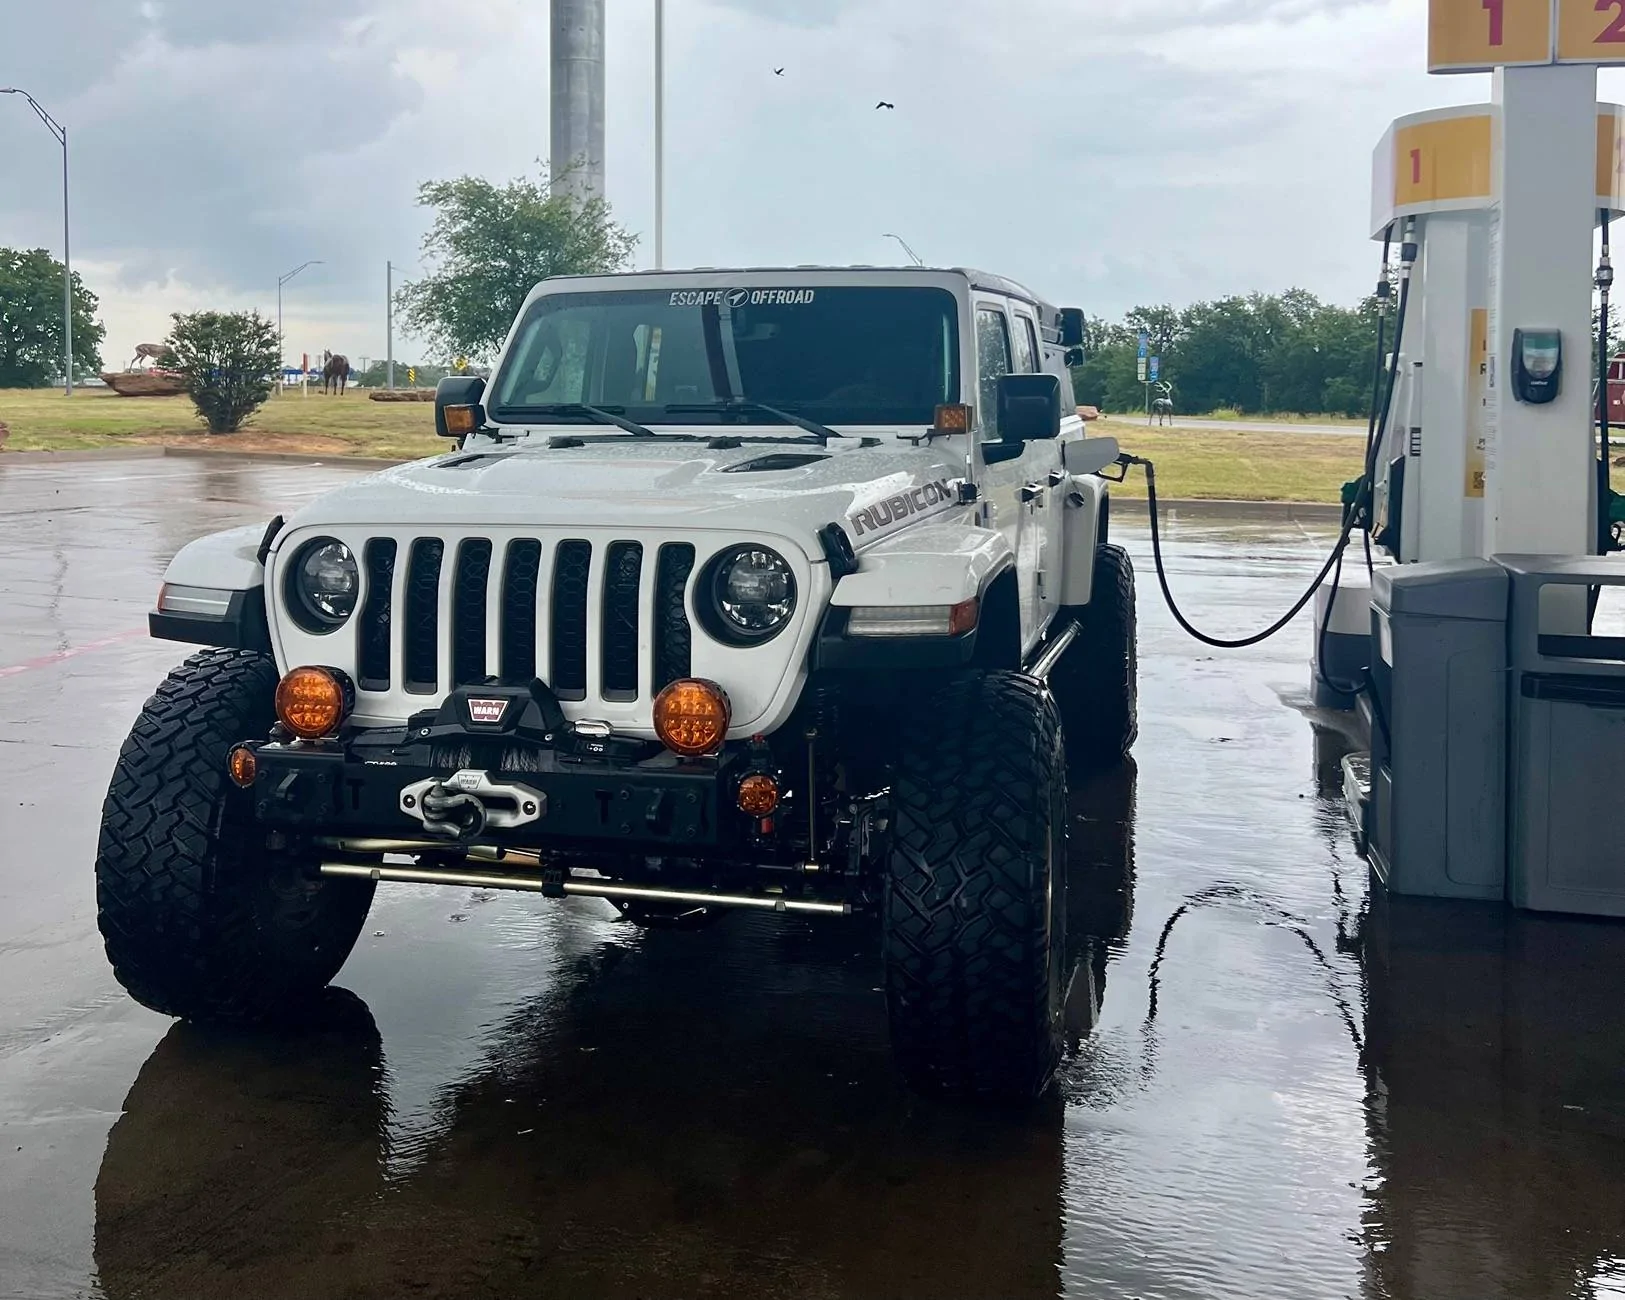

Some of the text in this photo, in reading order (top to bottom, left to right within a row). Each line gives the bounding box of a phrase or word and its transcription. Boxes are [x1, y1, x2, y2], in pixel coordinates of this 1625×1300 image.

[1483, 0, 1504, 45] 1
[1593, 0, 1625, 43] 2
[1410, 149, 1420, 184] 1
[669, 290, 815, 306] ESCAPE OFFROAD
[851, 478, 952, 536] RUBICON
[473, 706, 500, 715] WARN
